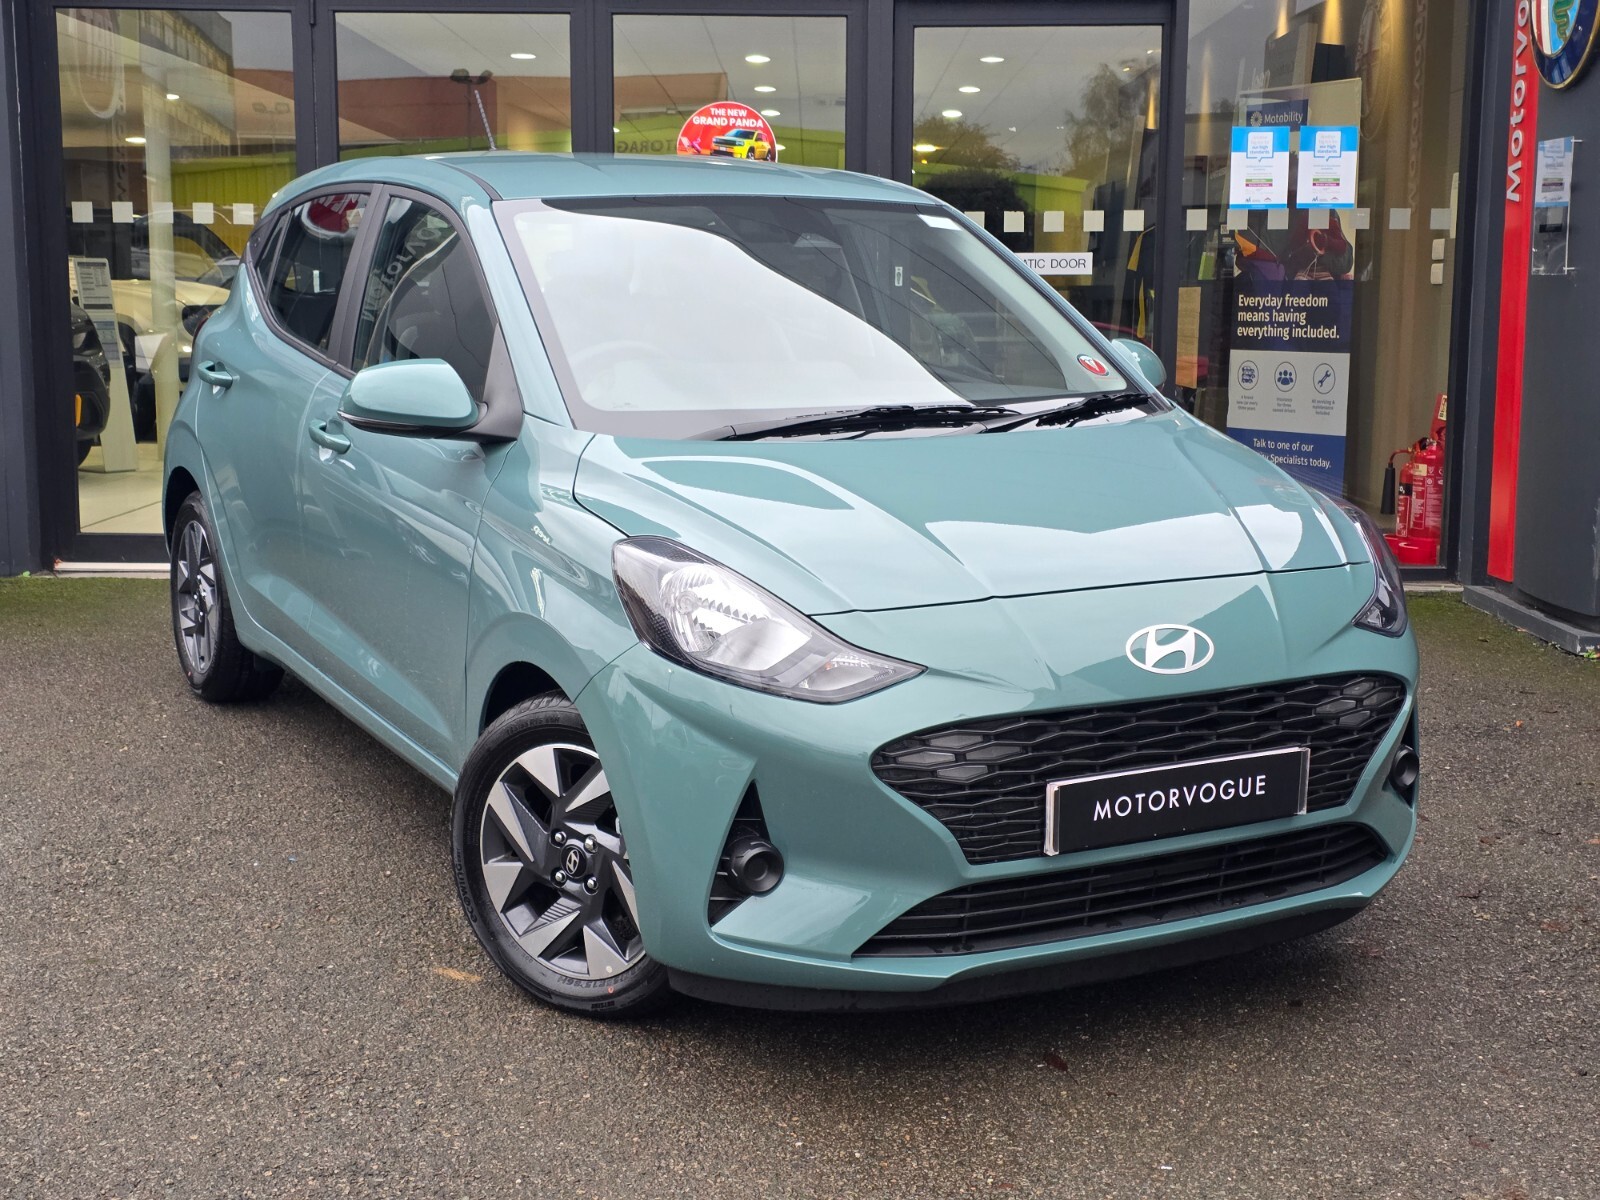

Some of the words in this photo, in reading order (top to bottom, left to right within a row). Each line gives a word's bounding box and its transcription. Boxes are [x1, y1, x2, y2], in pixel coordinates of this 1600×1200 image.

[1506, 0, 1529, 202] Motorvo
[710, 107, 726, 116] THE
[727, 108, 748, 117] NEW
[1264, 111, 1303, 124] Motability
[692, 116, 728, 126] GRAND
[729, 117, 764, 128] PANDA
[1050, 258, 1086, 269] DOOR
[1238, 293, 1283, 309] Everyday
[1285, 293, 1328, 307] freedom
[1238, 311, 1270, 322] means
[1272, 308, 1307, 325] having
[1237, 323, 1290, 340] everything
[1292, 324, 1340, 339] included.
[1253, 438, 1266, 448] Talk
[1268, 440, 1275, 449] to
[1277, 442, 1290, 450] one
[1292, 442, 1300, 451] of
[1301, 443, 1314, 452] our
[1270, 454, 1308, 466] Specialists
[1310, 457, 1332, 470] today.
[1093, 774, 1266, 821] MOTORVOGUE
